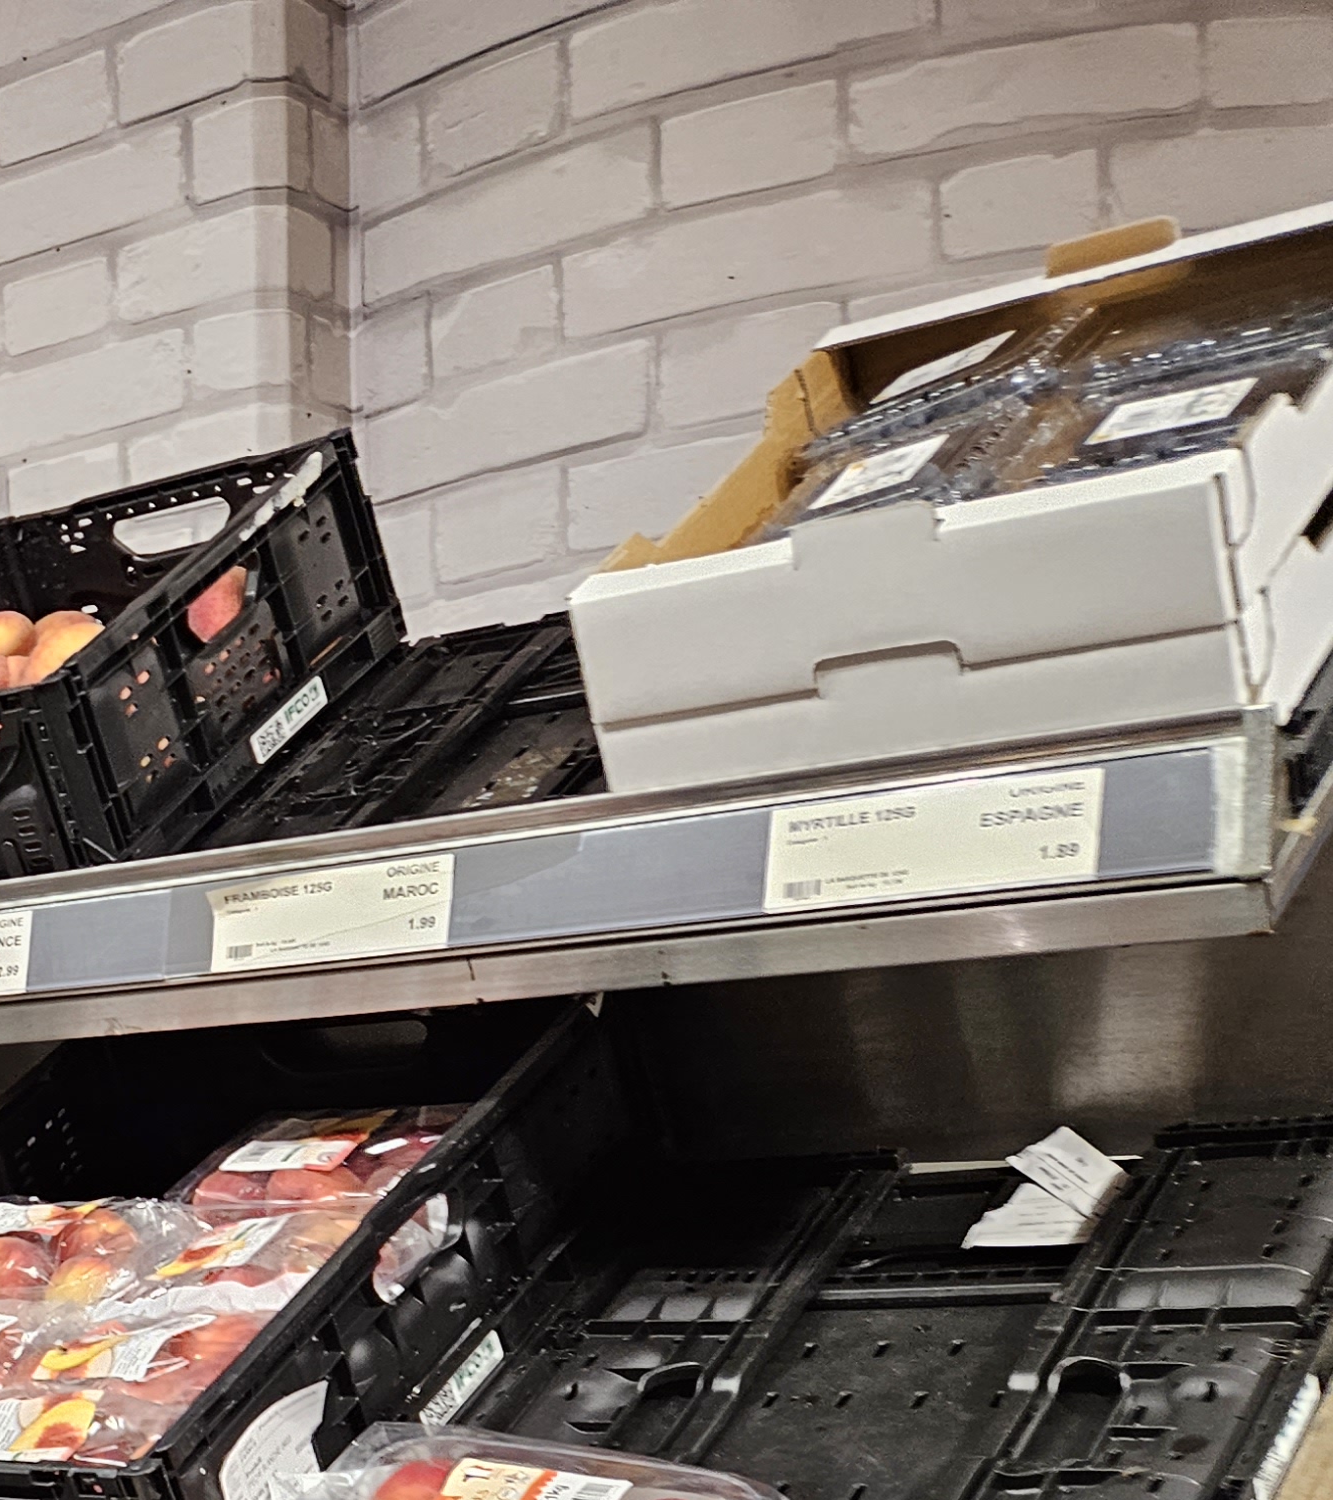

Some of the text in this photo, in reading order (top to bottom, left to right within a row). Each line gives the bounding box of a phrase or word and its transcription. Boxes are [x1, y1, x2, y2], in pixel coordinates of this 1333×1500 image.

[283, 692, 310, 725] IFCO
[788, 811, 870, 834] MYRTILLE
[979, 801, 1084, 828] ESPAGNE
[386, 860, 441, 878] ORIGINE
[223, 880, 334, 905] FRAMBOISE 125G
[382, 881, 440, 901] MAROC
[407, 915, 437, 931] 1.99
